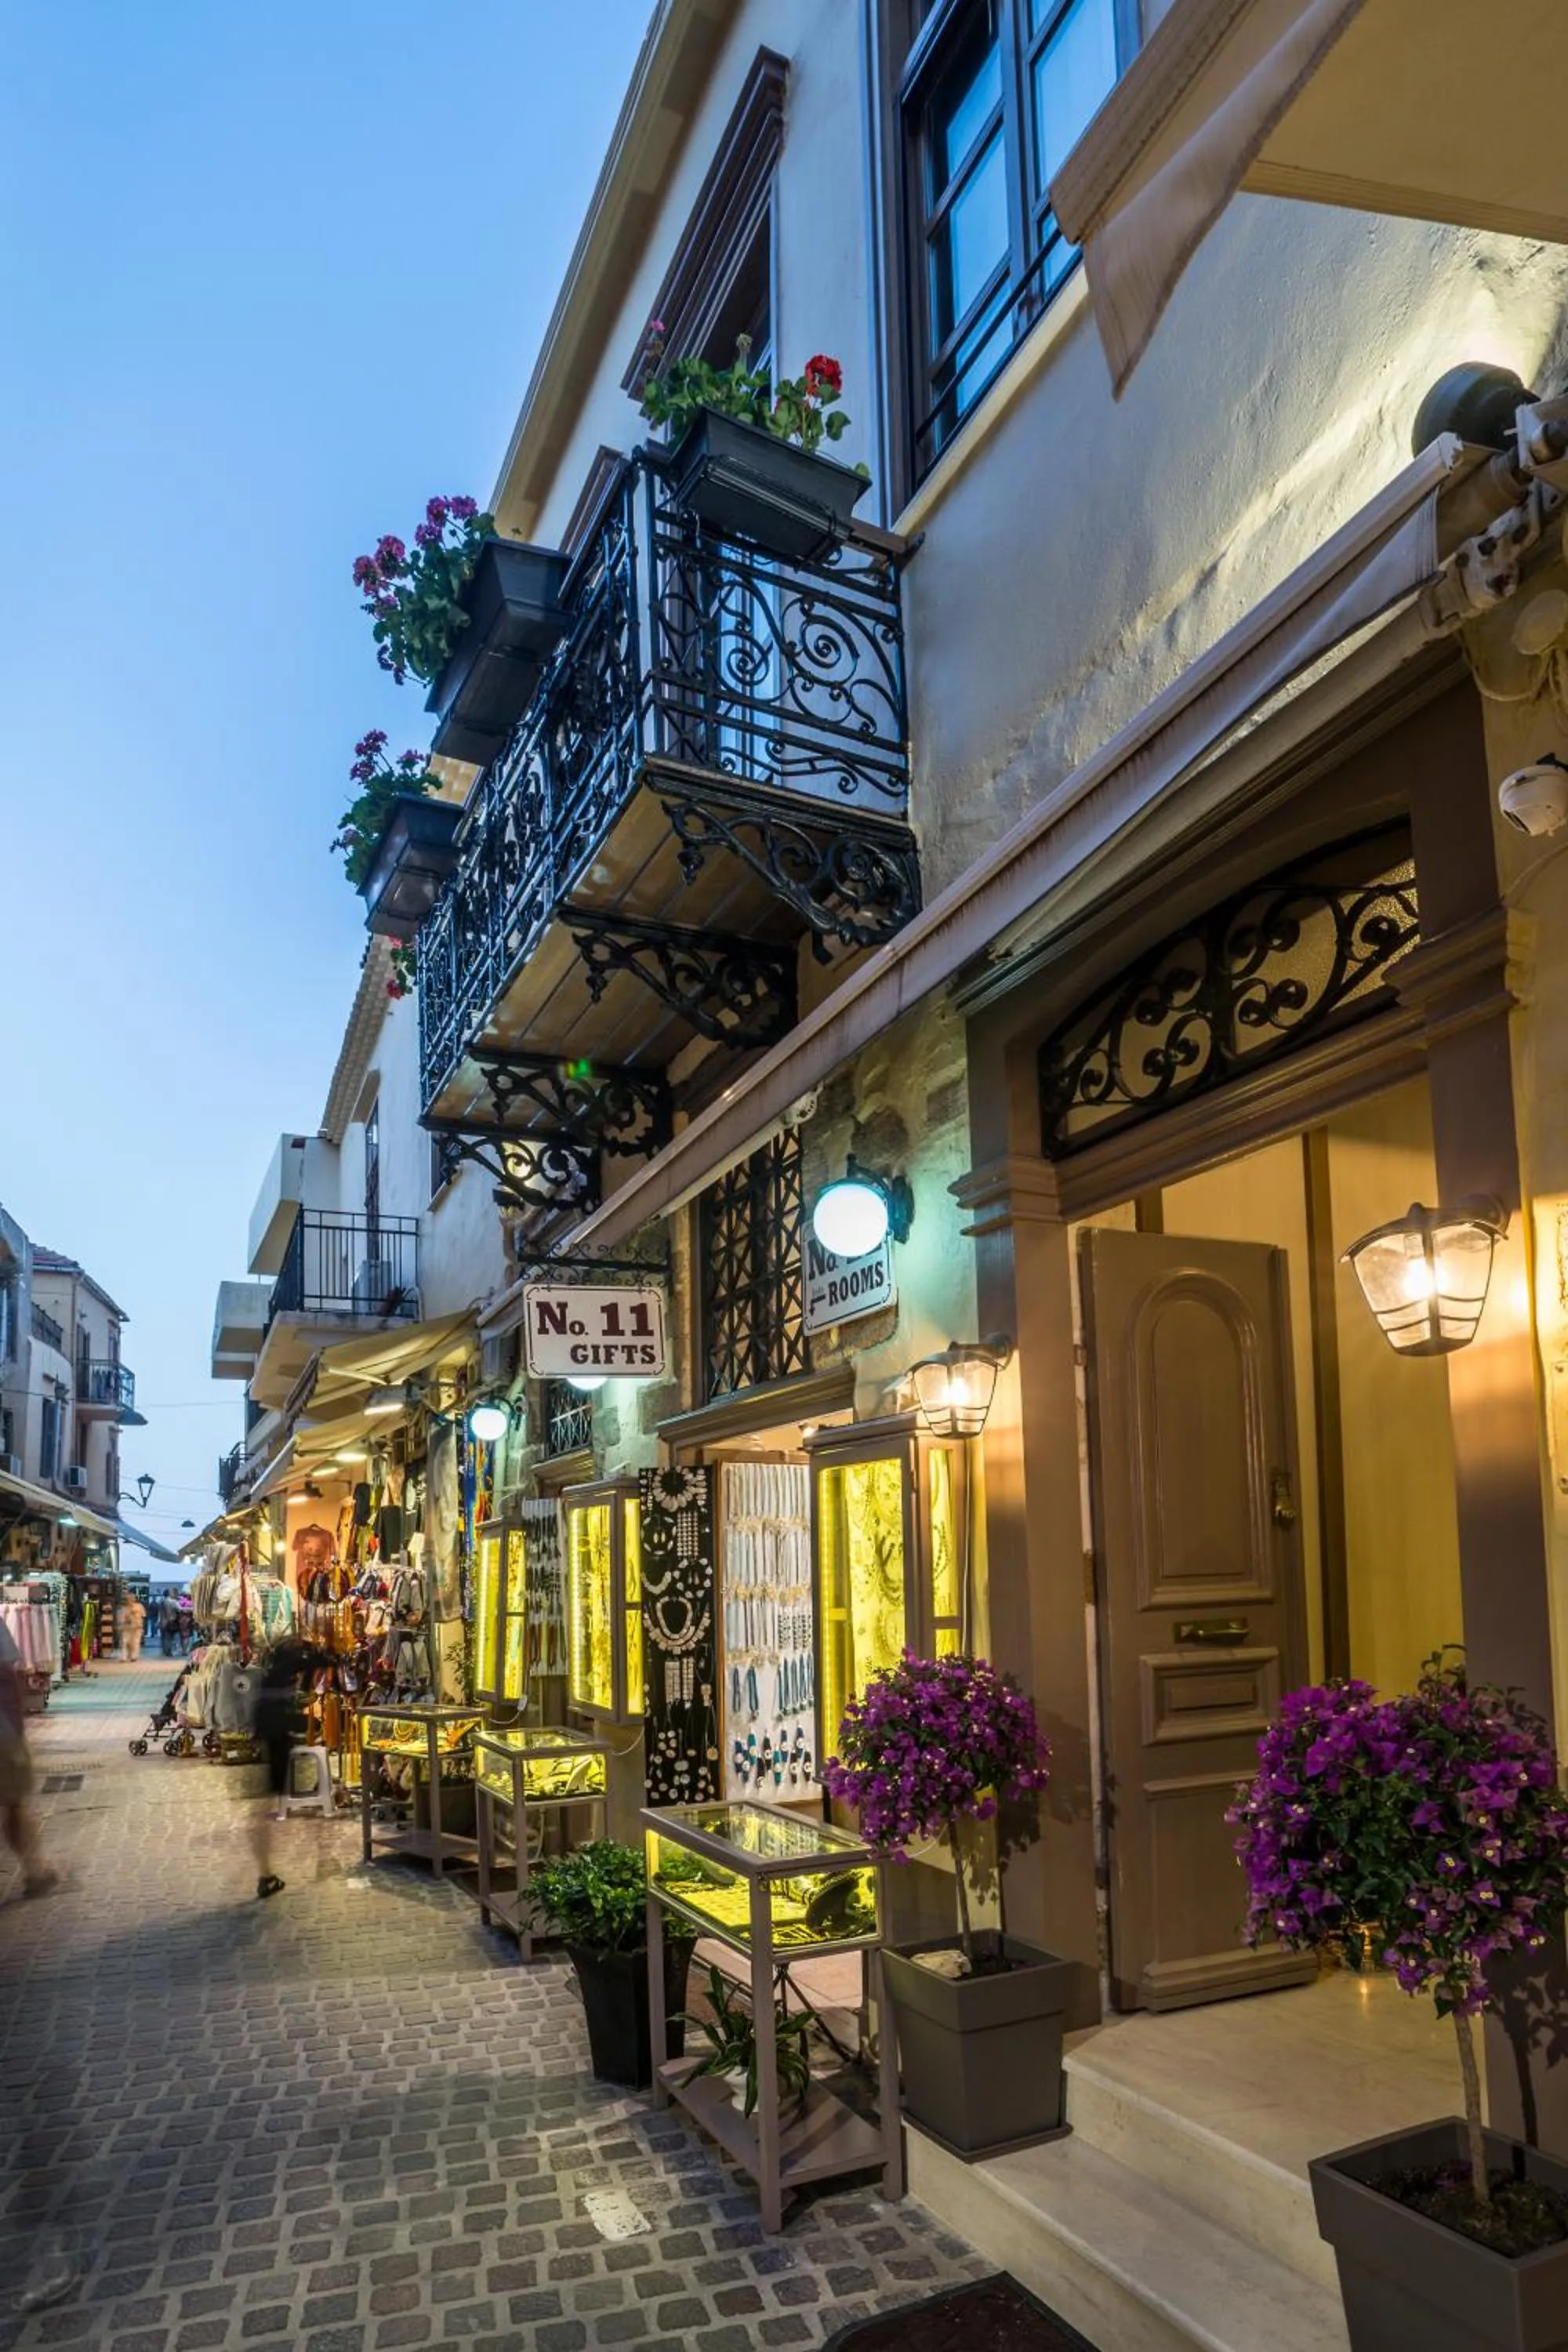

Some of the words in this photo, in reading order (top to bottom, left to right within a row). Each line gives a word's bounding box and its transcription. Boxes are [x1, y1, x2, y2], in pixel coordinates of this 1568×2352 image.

[828, 1260, 884, 1307] ROOMS
[536, 1301, 589, 1335] No.
[601, 1302, 655, 1336] 11
[570, 1344, 656, 1365] GIFTS
